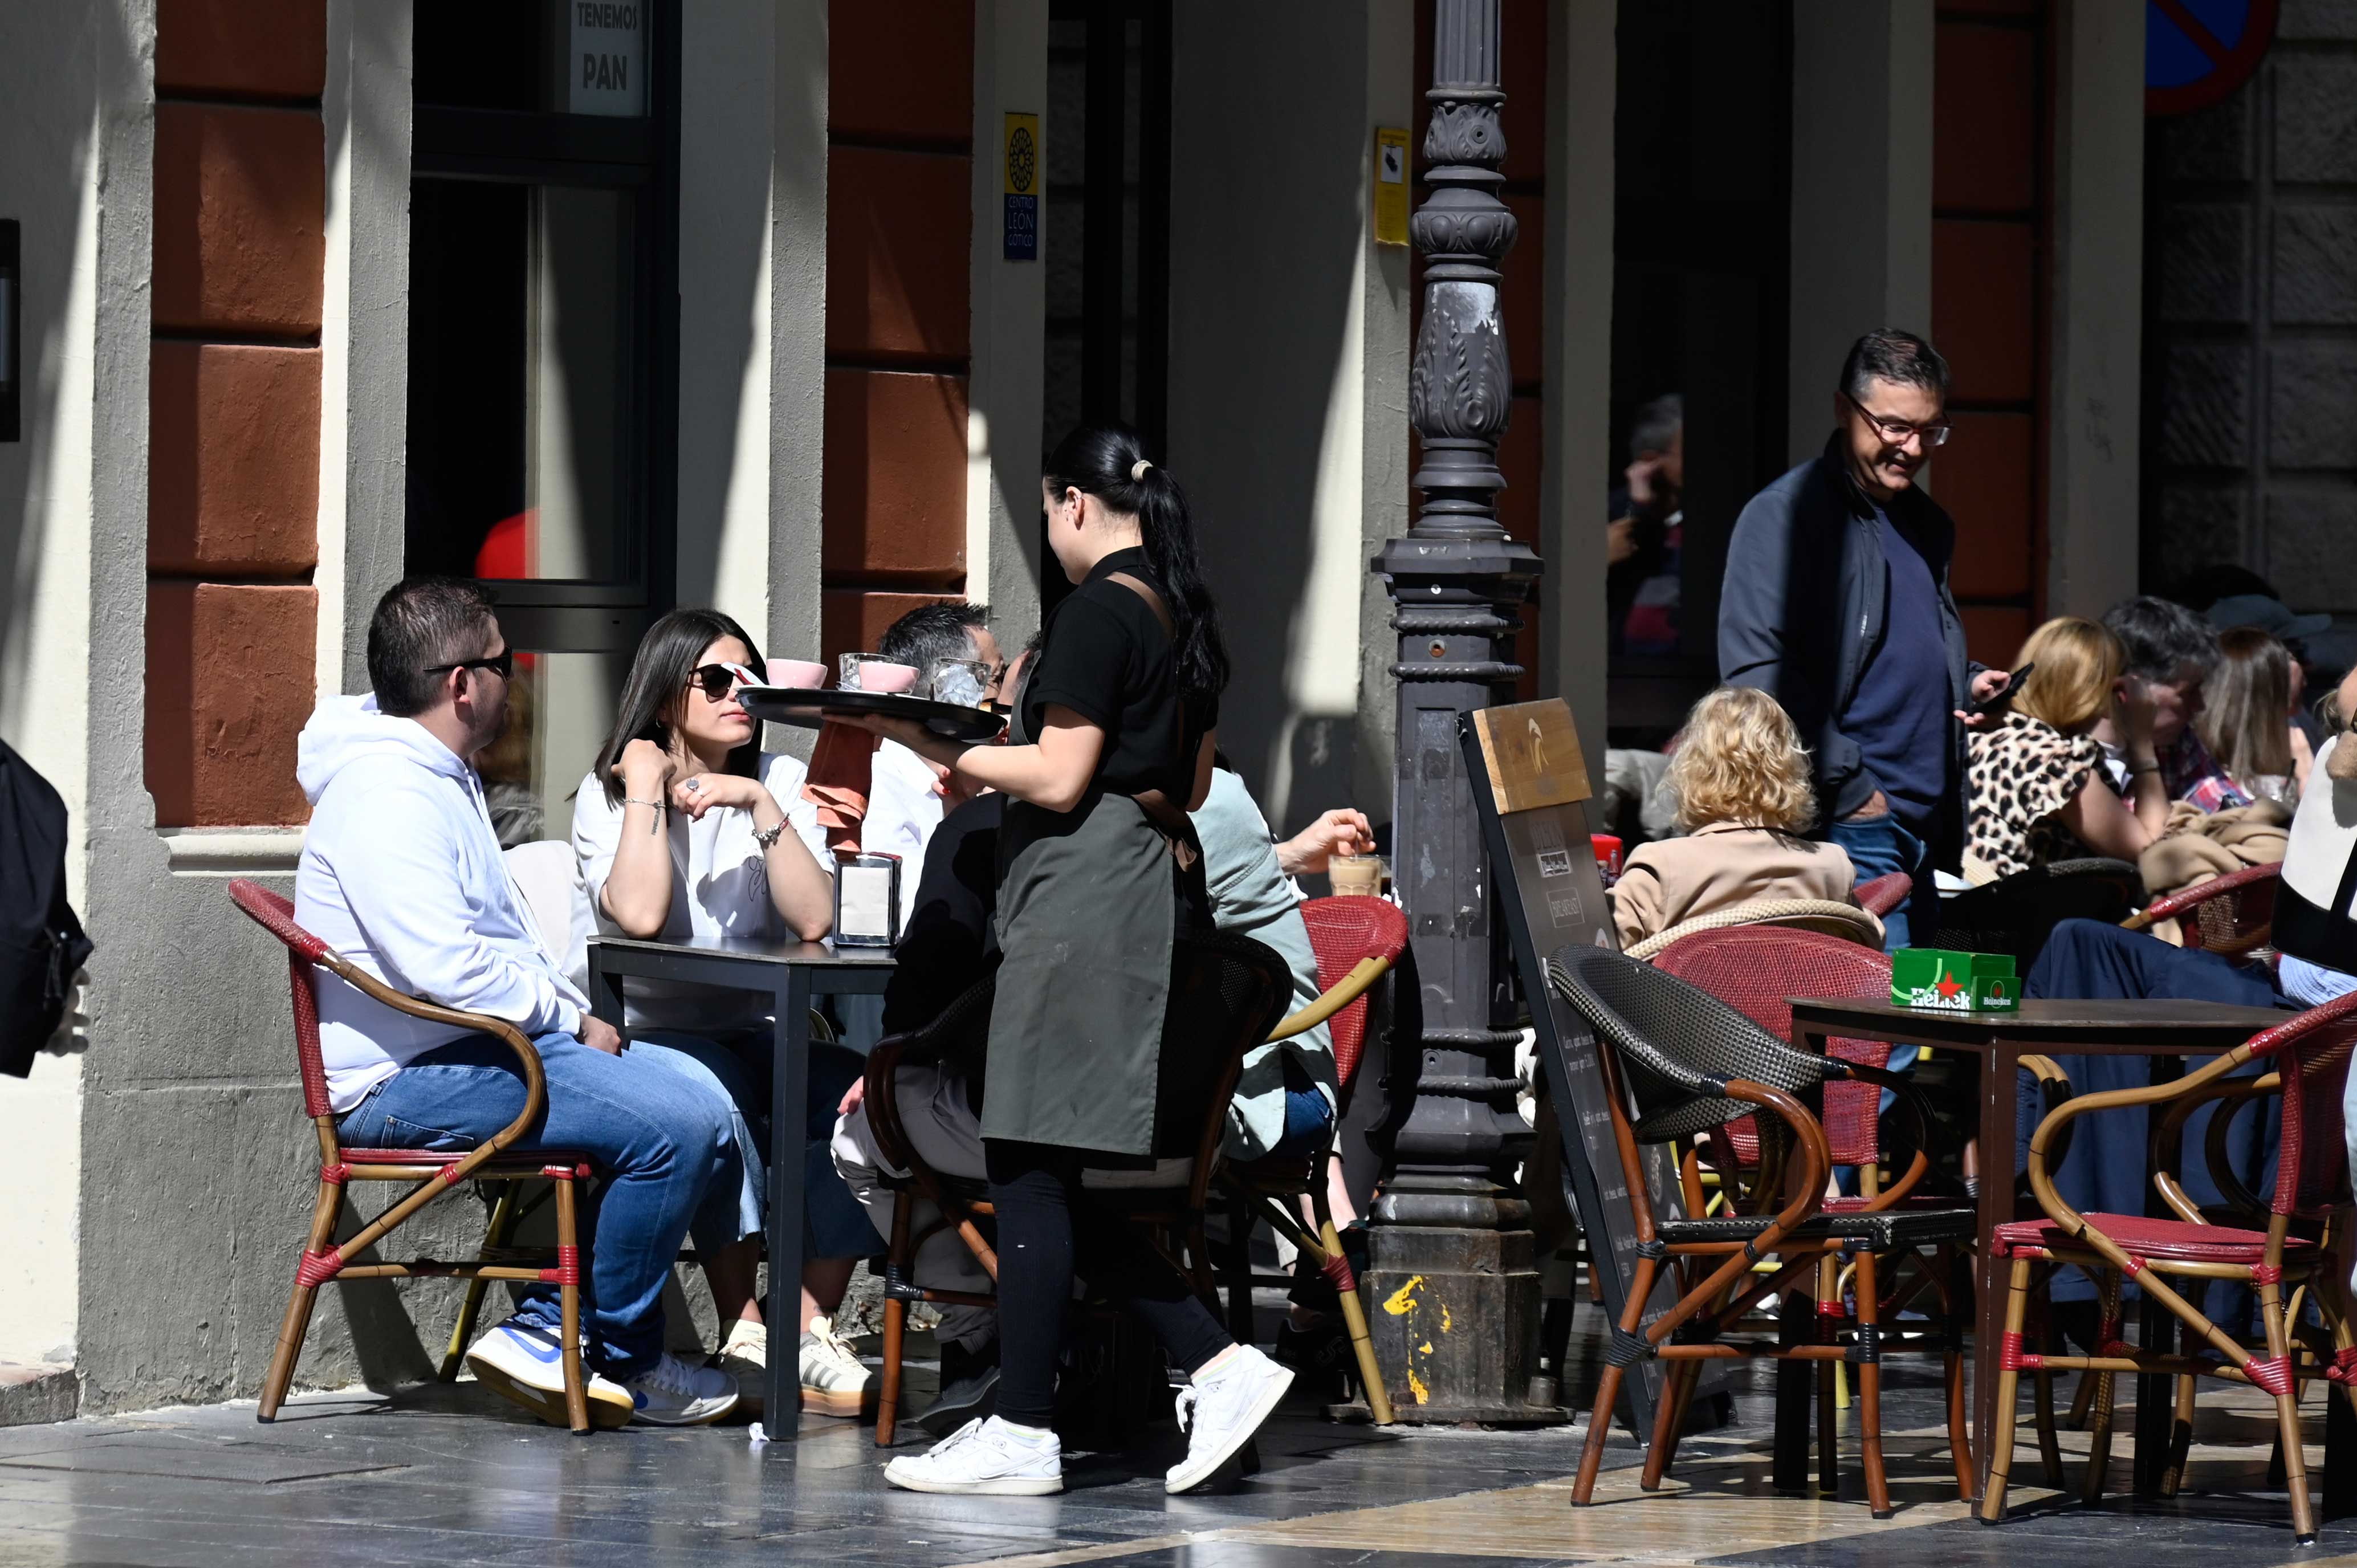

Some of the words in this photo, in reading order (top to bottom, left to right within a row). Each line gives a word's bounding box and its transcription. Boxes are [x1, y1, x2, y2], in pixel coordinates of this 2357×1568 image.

[577, 2, 637, 30] TENEMOS
[583, 54, 627, 91] PAN
[1008, 196, 1033, 210] CENTRO
[1008, 210, 1033, 230] LEÓN
[1008, 230, 1033, 247] GÓTICO
[1984, 997, 2011, 1005] Heineken
